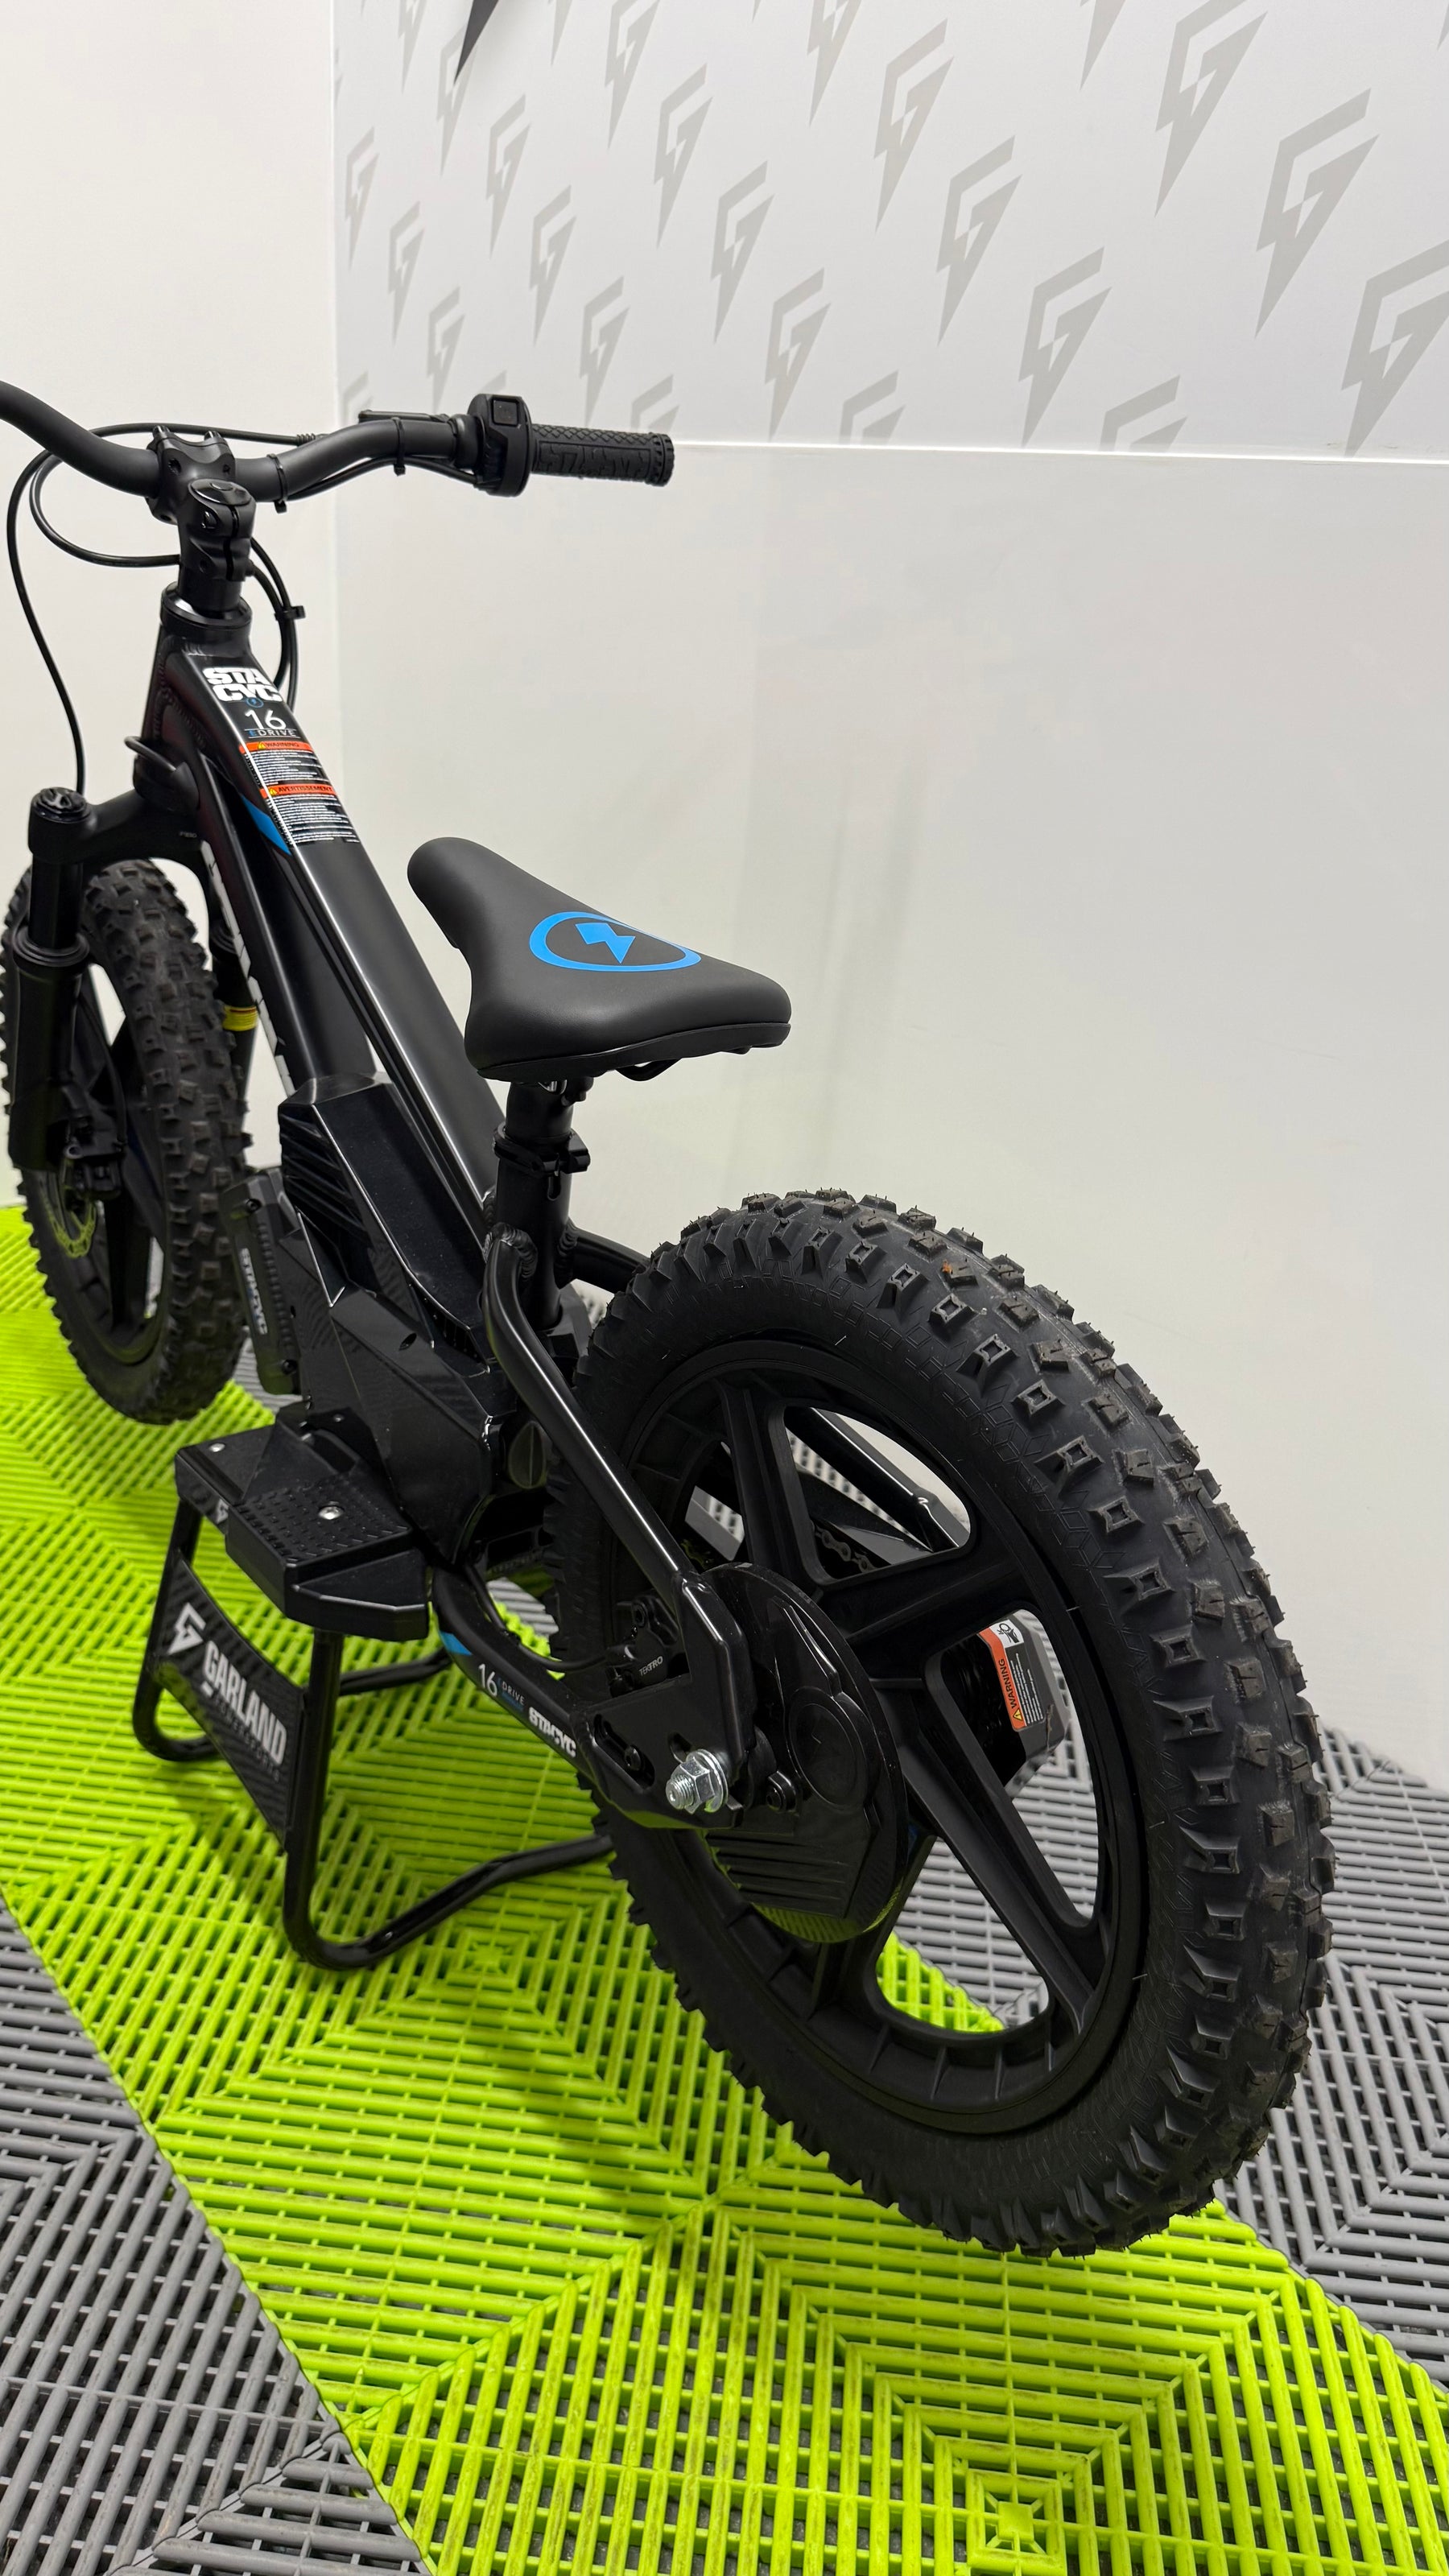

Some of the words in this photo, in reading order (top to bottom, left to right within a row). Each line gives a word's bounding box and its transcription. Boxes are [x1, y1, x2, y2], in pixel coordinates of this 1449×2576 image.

[203, 667, 271, 685] STA
[213, 683, 283, 702] CYC
[245, 710, 287, 730] 16
[638, 1655, 664, 1677] TEKTRO
[998, 1658, 1017, 1709] WARNING
[203, 1639, 287, 1767] GARLAND
[478, 1663, 497, 1698] 16
[528, 1707, 577, 1758] STACYC
